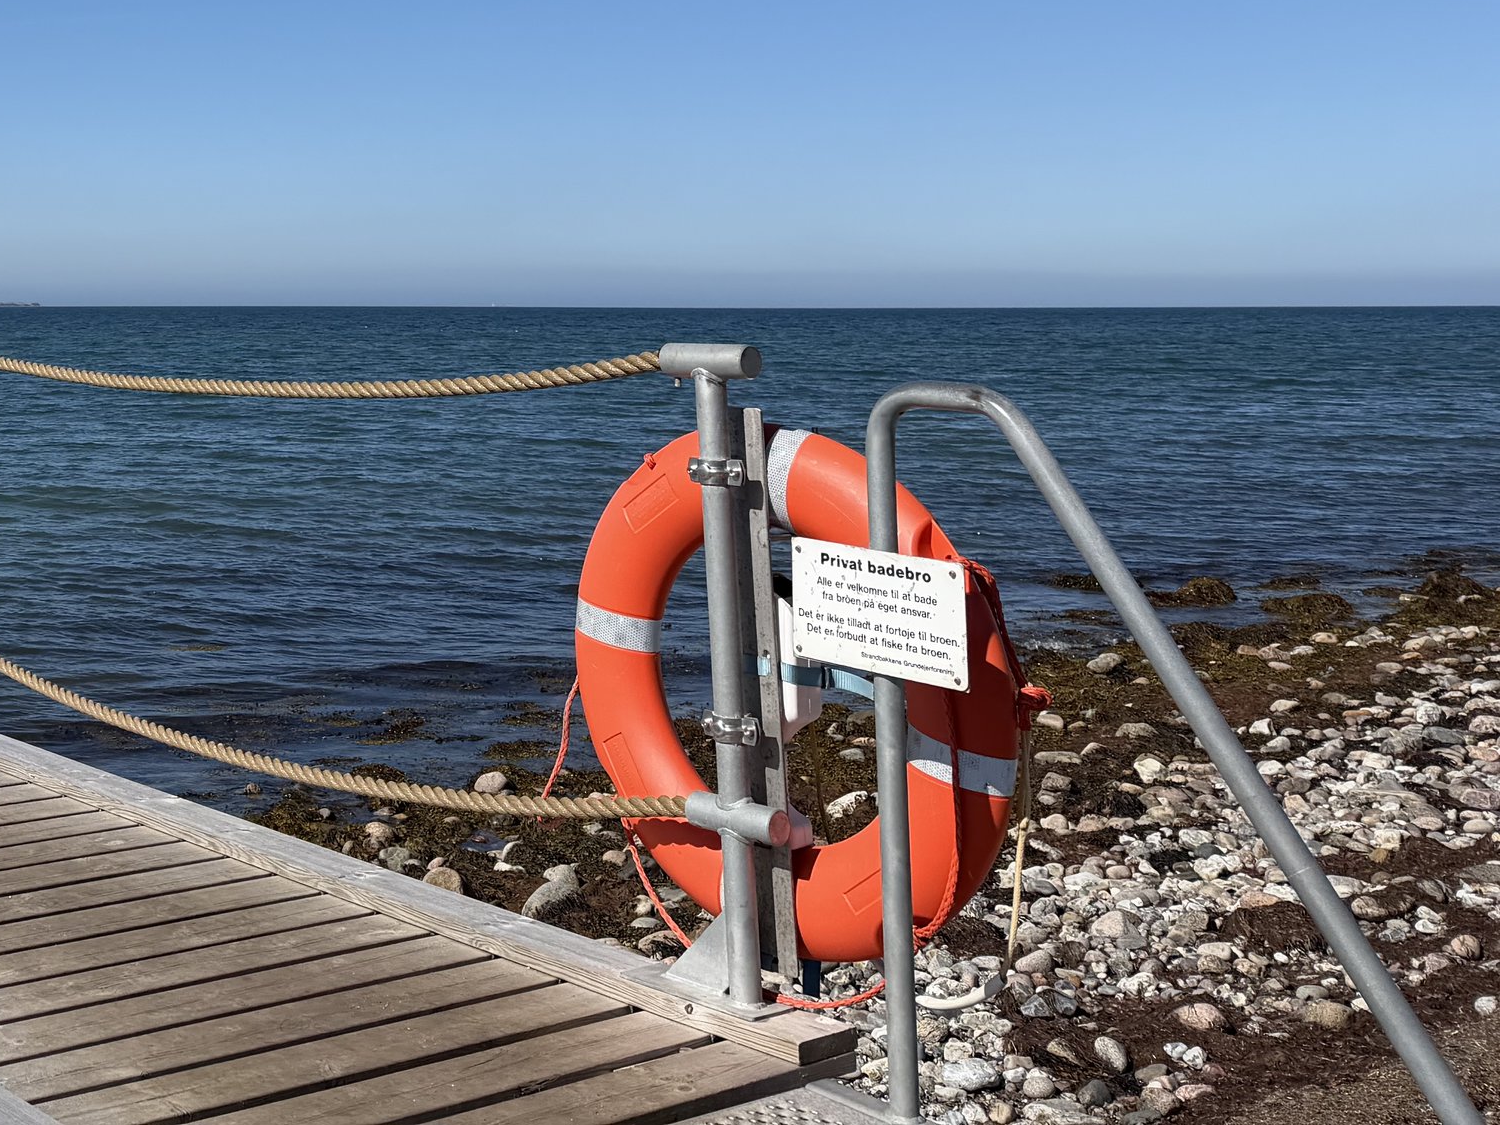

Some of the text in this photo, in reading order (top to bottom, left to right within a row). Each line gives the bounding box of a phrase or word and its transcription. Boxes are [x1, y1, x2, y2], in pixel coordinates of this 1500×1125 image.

[820, 552, 931, 583] Privat badebro
[817, 576, 938, 606] Alle er velkomne til at bade
[822, 590, 932, 620] fra broen på eget ansvar.
[798, 608, 960, 648] Det er ikke tilladt at fortøje til broen.
[807, 623, 951, 660] Det er forbudt at fiske fra broen.
[904, 660, 955, 676] Grundejerforening
